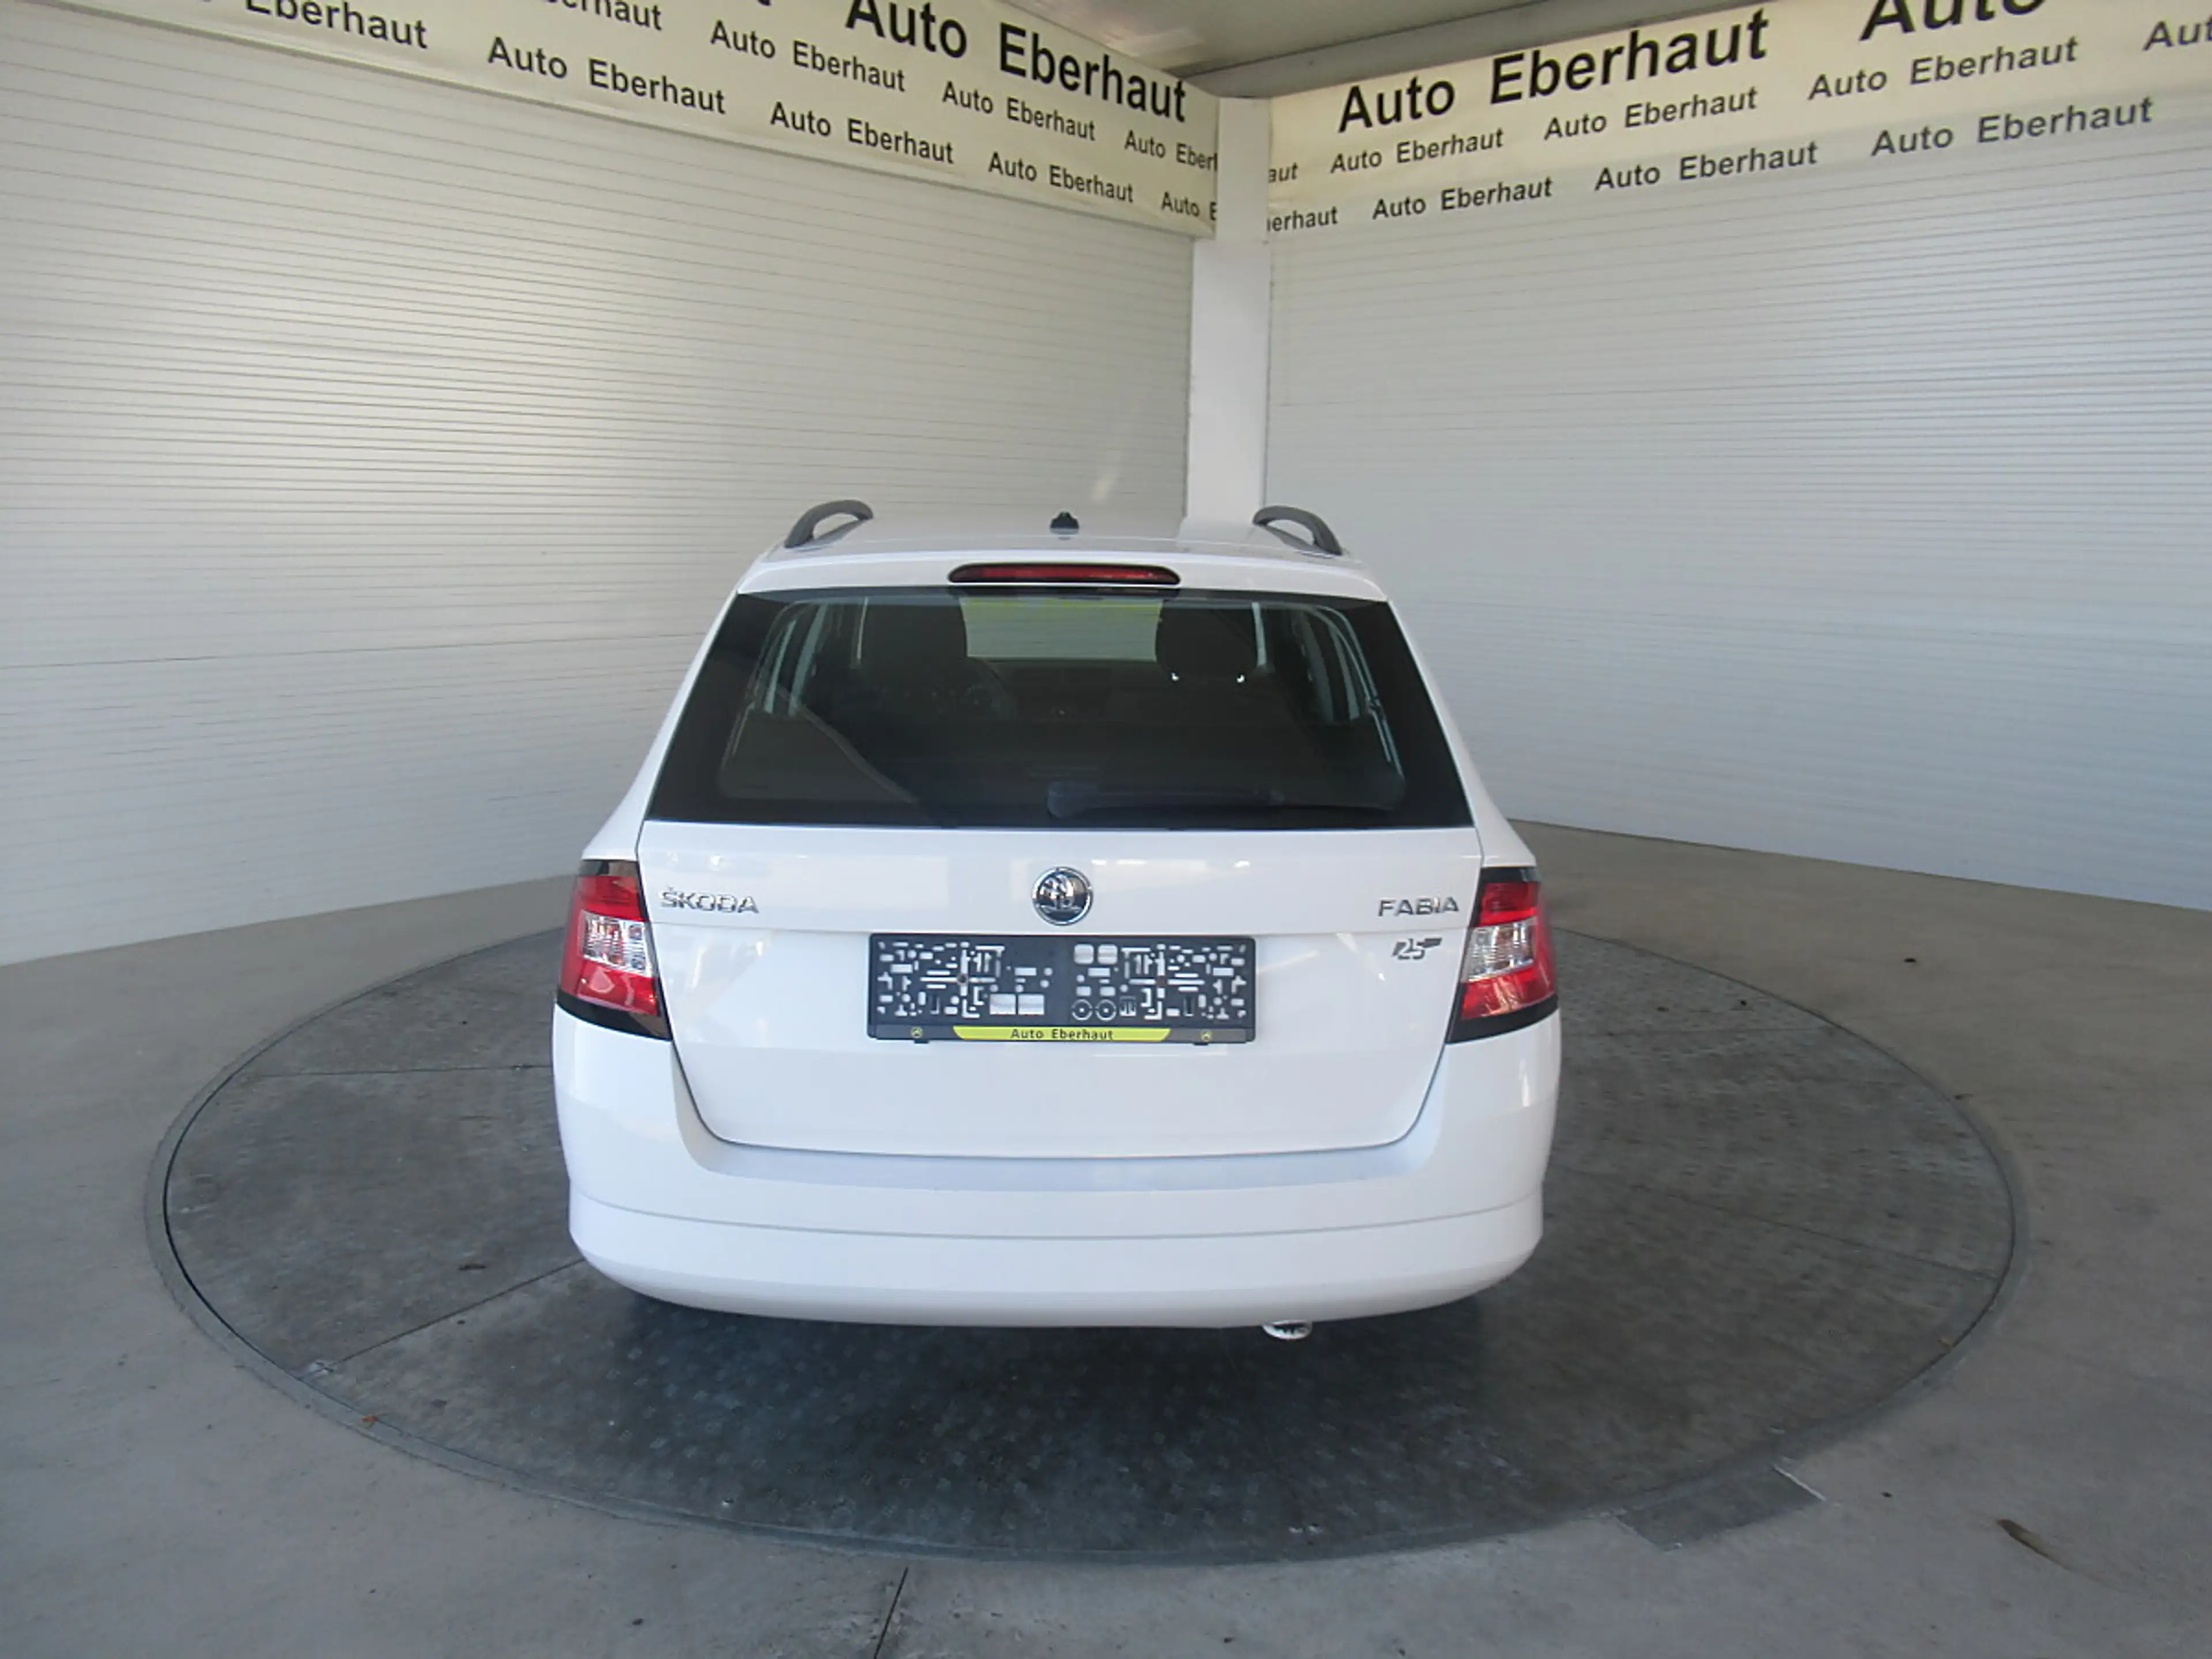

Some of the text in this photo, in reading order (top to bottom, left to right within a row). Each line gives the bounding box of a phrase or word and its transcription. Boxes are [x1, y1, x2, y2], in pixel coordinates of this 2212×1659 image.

[488, 36, 725, 115] Auto Eberhaut
[710, 20, 906, 92] Auto Eberhaut
[846, 0, 1185, 122] Auto Eberhaut
[1338, 10, 1768, 133] Auto Eberhaut
[1808, 37, 2078, 100] Auto Eberhaut
[770, 101, 953, 164] Auto Eberhaut
[942, 81, 1095, 141] Auto Eberhaut
[1544, 87, 1757, 141] Auto Eberhaut
[1871, 97, 2153, 156] Auto Eberhaut
[1124, 130, 1166, 158] Auto
[1330, 128, 1503, 173] Auto Eberhaut
[1595, 142, 1817, 191] Auto Eberhaut
[988, 151, 1133, 203] Auto Eberhaut
[1373, 177, 1552, 219] Auto Eberhaut
[1161, 191, 1200, 217] Auto
[660, 886, 759, 914] ŠKODA
[1378, 897, 1460, 916] FABIA
[1010, 1029, 1113, 1040] Auto Eberhaut
